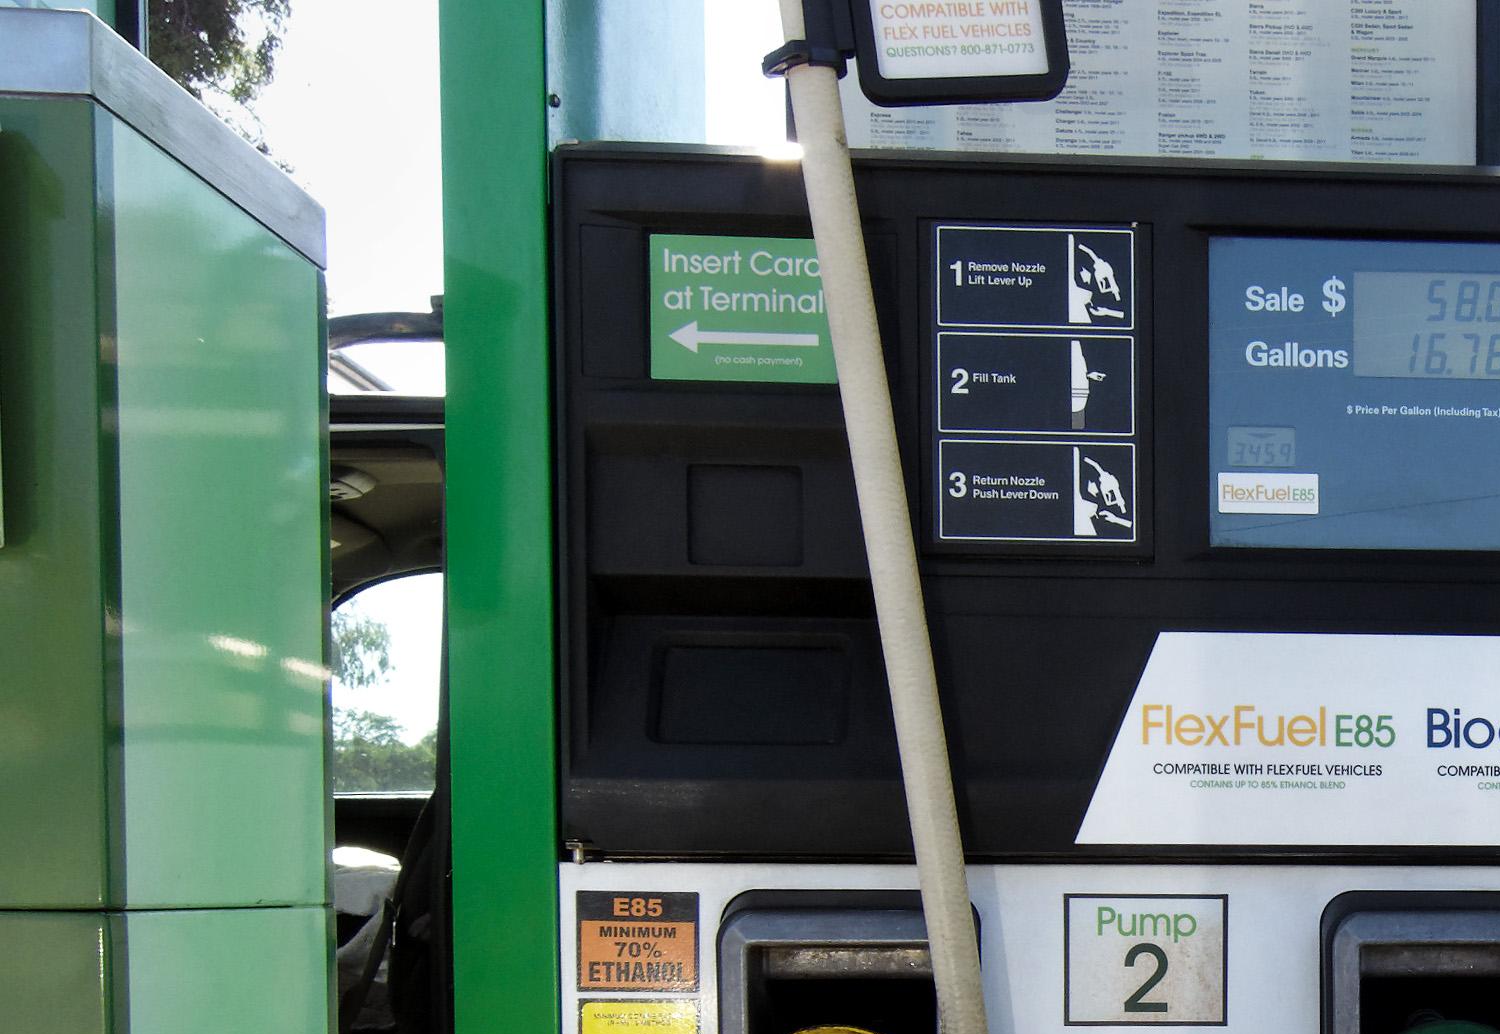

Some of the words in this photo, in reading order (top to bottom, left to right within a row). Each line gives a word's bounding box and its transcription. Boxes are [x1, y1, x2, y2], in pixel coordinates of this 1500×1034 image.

[880, 2, 984, 20] COMPATIBLE
[990, 2, 1029, 17] WITH
[883, 26, 918, 41] FLEX
[923, 25, 957, 40] FUEL
[961, 23, 1032, 39] VEHICLES
[886, 45, 957, 59] QUESTIONS?
[960, 43, 1035, 57] 800-871-0773
[664, 248, 742, 274] Insert
[949, 260, 963, 286] 1
[968, 262, 1009, 273] Remove
[1011, 262, 1046, 274] Nozzle
[968, 275, 985, 286] Lift
[987, 276, 1016, 286] Lever
[1017, 277, 1033, 288] Up
[664, 286, 693, 310] at
[700, 286, 824, 314] Terminal
[1245, 285, 1305, 314] Sale
[1322, 275, 1346, 317] $
[715, 356, 732, 366] (no
[733, 356, 756, 365] cash
[758, 357, 803, 368] payment)
[1245, 341, 1349, 369] Gallons
[951, 368, 969, 394] 2
[973, 373, 988, 384] Fill
[990, 373, 1016, 385] Tank
[1355, 404, 1379, 416] Price
[1382, 405, 1398, 416] Per
[1400, 405, 1432, 417] Gallon
[1433, 406, 1481, 419] (Including
[949, 471, 967, 498] 3
[973, 475, 1009, 487] Return
[1010, 476, 1046, 487] Nozzle
[1222, 483, 1291, 502] FlexFuel
[1292, 487, 1316, 502] E85
[973, 488, 999, 499] Push
[1000, 488, 1029, 500] Lever
[1029, 489, 1059, 501] Down
[1142, 703, 1327, 748] FlexFuel
[1335, 714, 1397, 749] E85
[1153, 763, 1231, 775] COMPATIBLE
[1234, 764, 1264, 775] WITH
[1325, 765, 1383, 777] VEHICLES
[1190, 779, 1233, 789] CONTAINS
[1234, 780, 1246, 789] UP
[1248, 780, 1259, 789] TO
[1280, 780, 1318, 790] ETHANOL
[1319, 780, 1346, 790] BLEND
[613, 897, 663, 917] E85
[599, 926, 677, 939] MINIMUM
[1097, 906, 1198, 944] Pump
[614, 942, 663, 959] 70%
[588, 961, 687, 983] ETHANOL
[1124, 942, 1169, 1013] 2
